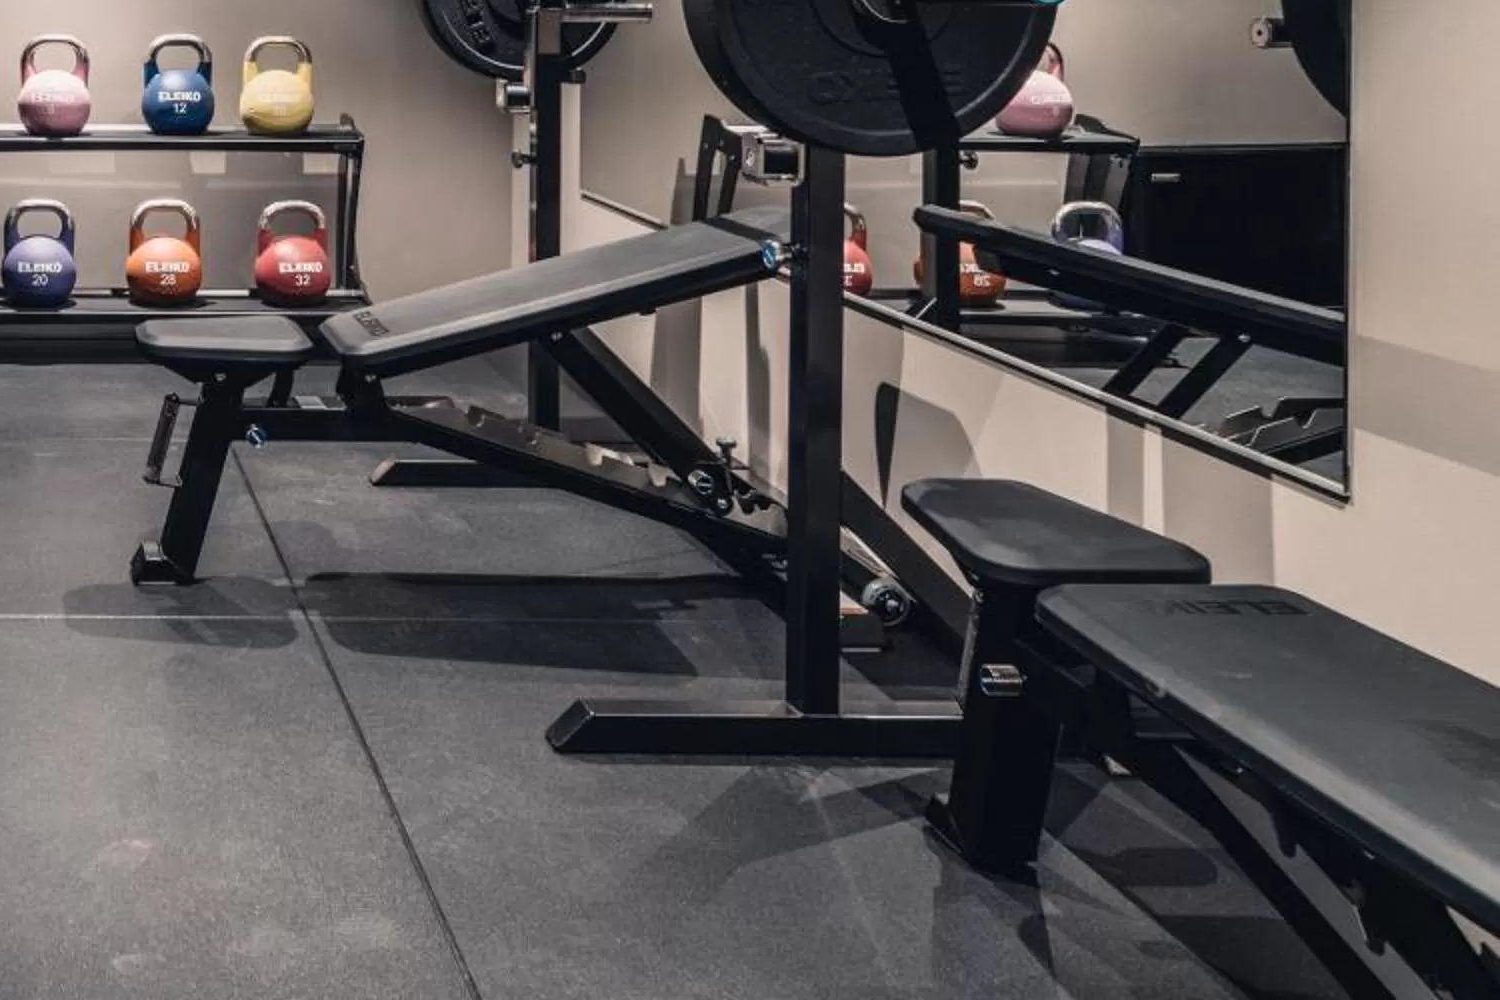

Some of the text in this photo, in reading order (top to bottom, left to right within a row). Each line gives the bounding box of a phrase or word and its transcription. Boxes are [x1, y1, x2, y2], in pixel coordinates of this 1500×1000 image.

[157, 90, 202, 102] ELEIKO
[172, 103, 188, 114] 12
[17, 261, 63, 273] ELEIKO
[145, 261, 190, 273] ELEIKO
[278, 261, 323, 274] ELEIKO
[31, 273, 49, 287] 20
[294, 273, 311, 287] 32
